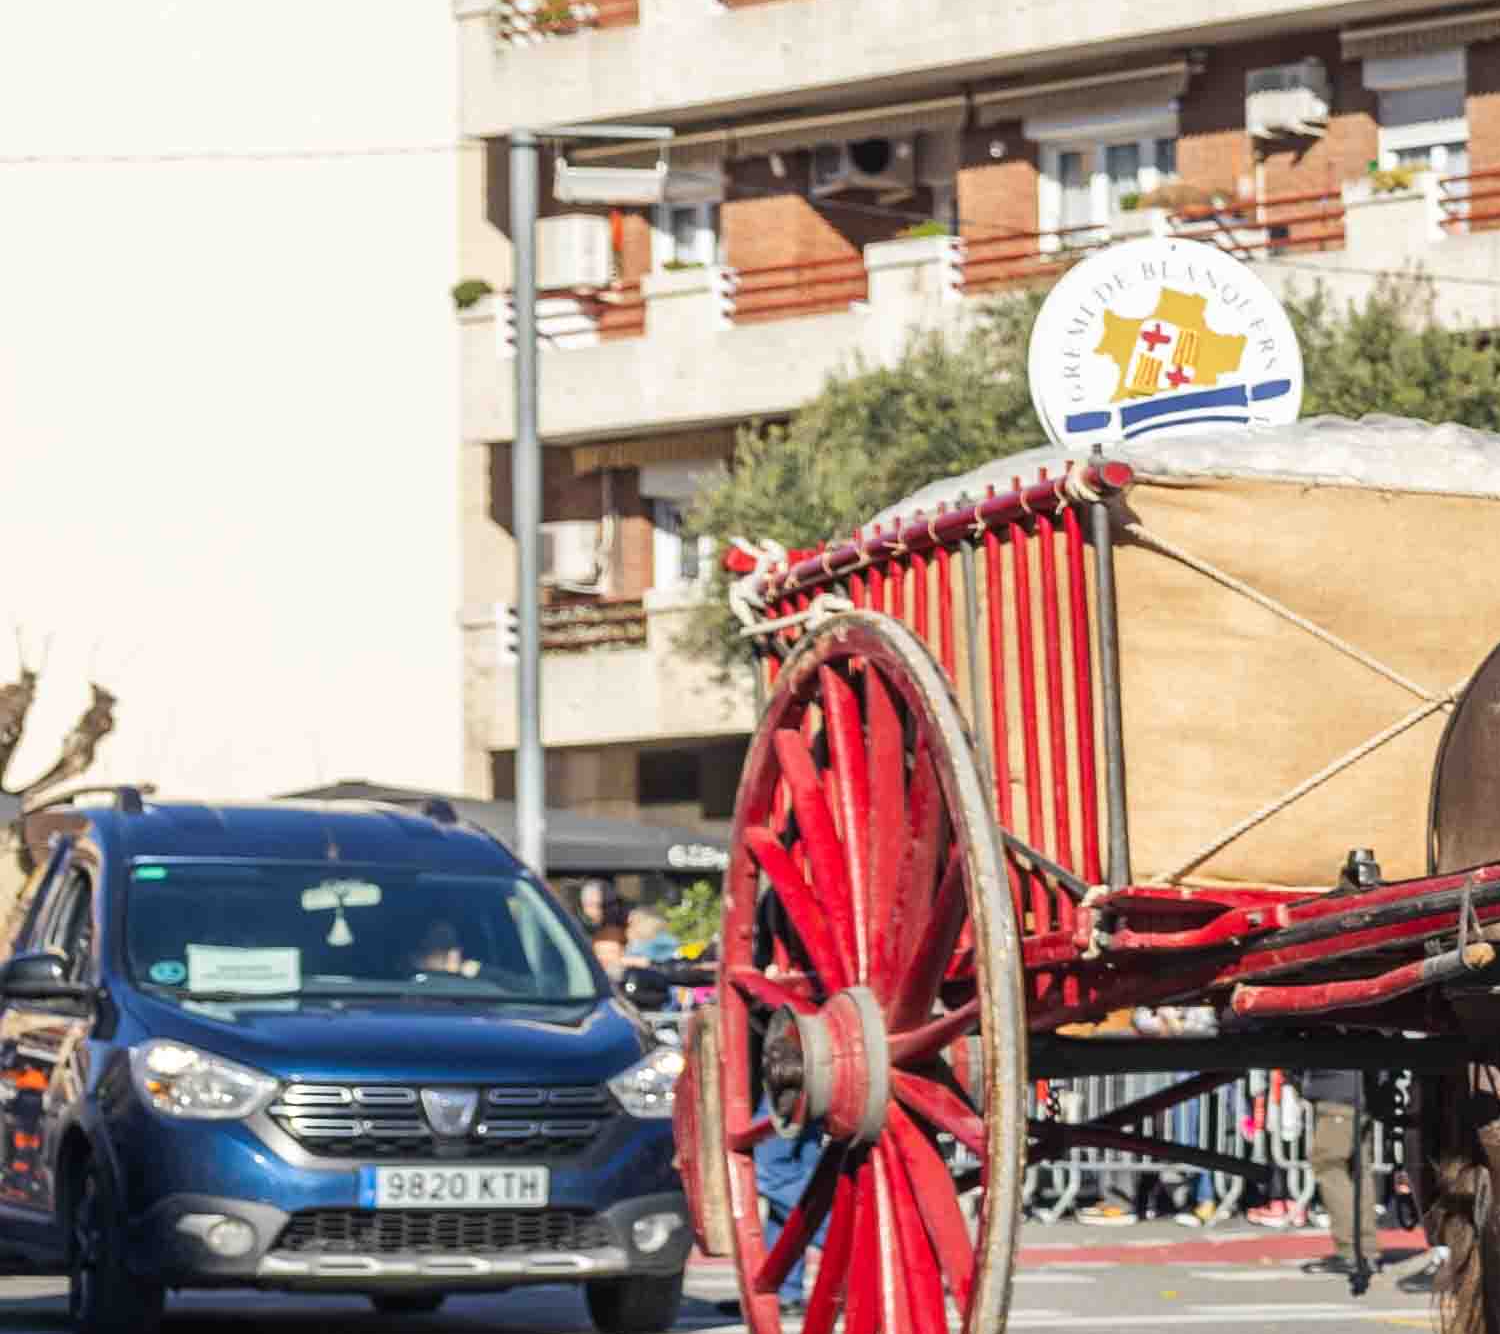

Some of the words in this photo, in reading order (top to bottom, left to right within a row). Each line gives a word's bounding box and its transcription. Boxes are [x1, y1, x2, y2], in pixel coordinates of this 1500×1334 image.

[1063, 304, 1097, 403] GREMI
[1092, 272, 1130, 306] DE
[387, 1172, 467, 1201] 9820
[479, 1172, 539, 1200] KTH
